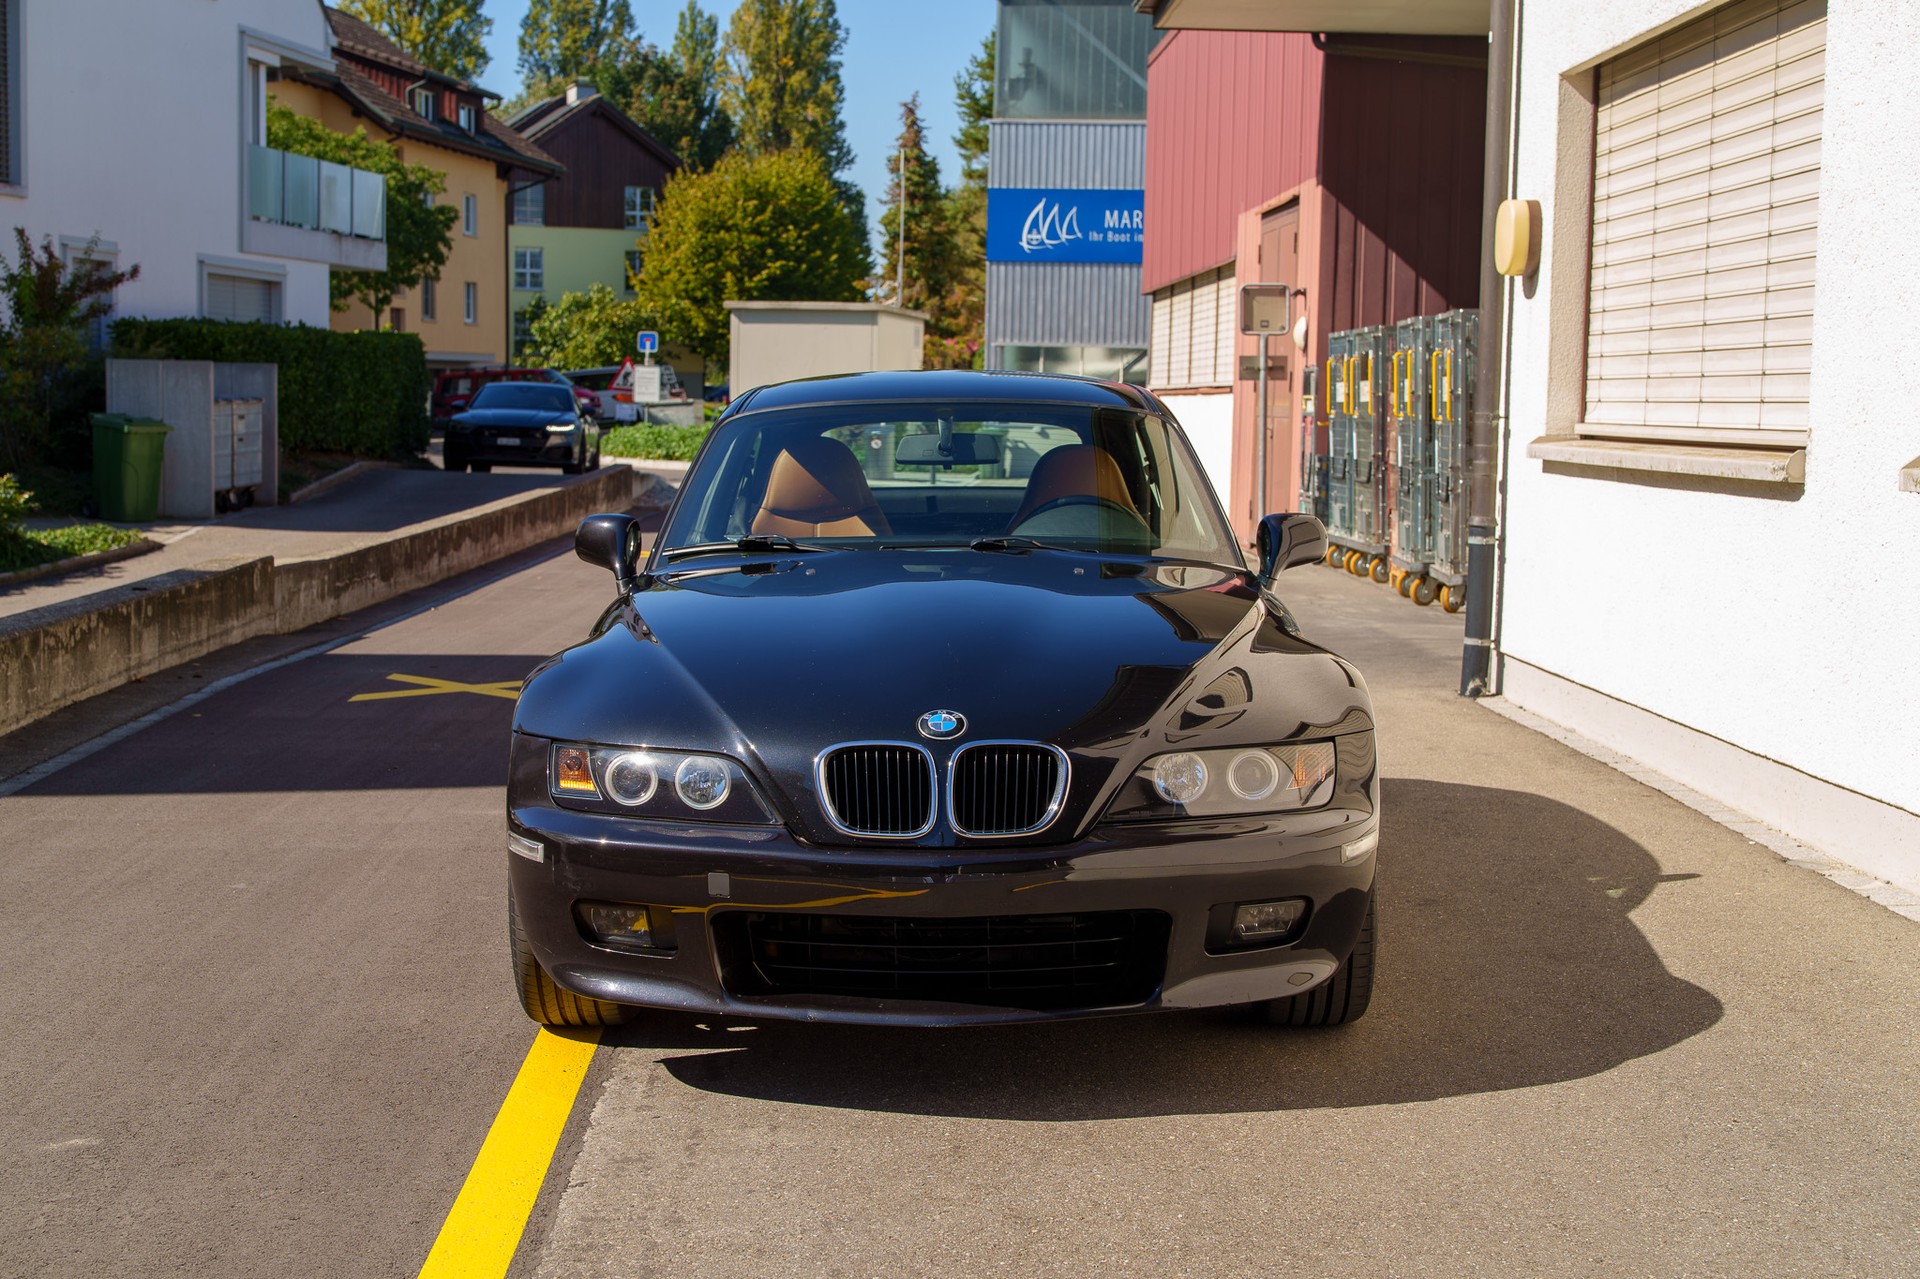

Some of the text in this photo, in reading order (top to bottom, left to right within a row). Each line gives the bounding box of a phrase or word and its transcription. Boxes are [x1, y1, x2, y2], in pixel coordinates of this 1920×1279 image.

[1104, 209, 1143, 229] MAR
[1089, 230, 1104, 242] Ihr
[1107, 231, 1131, 243] Boot
[923, 710, 961, 720] BMW
